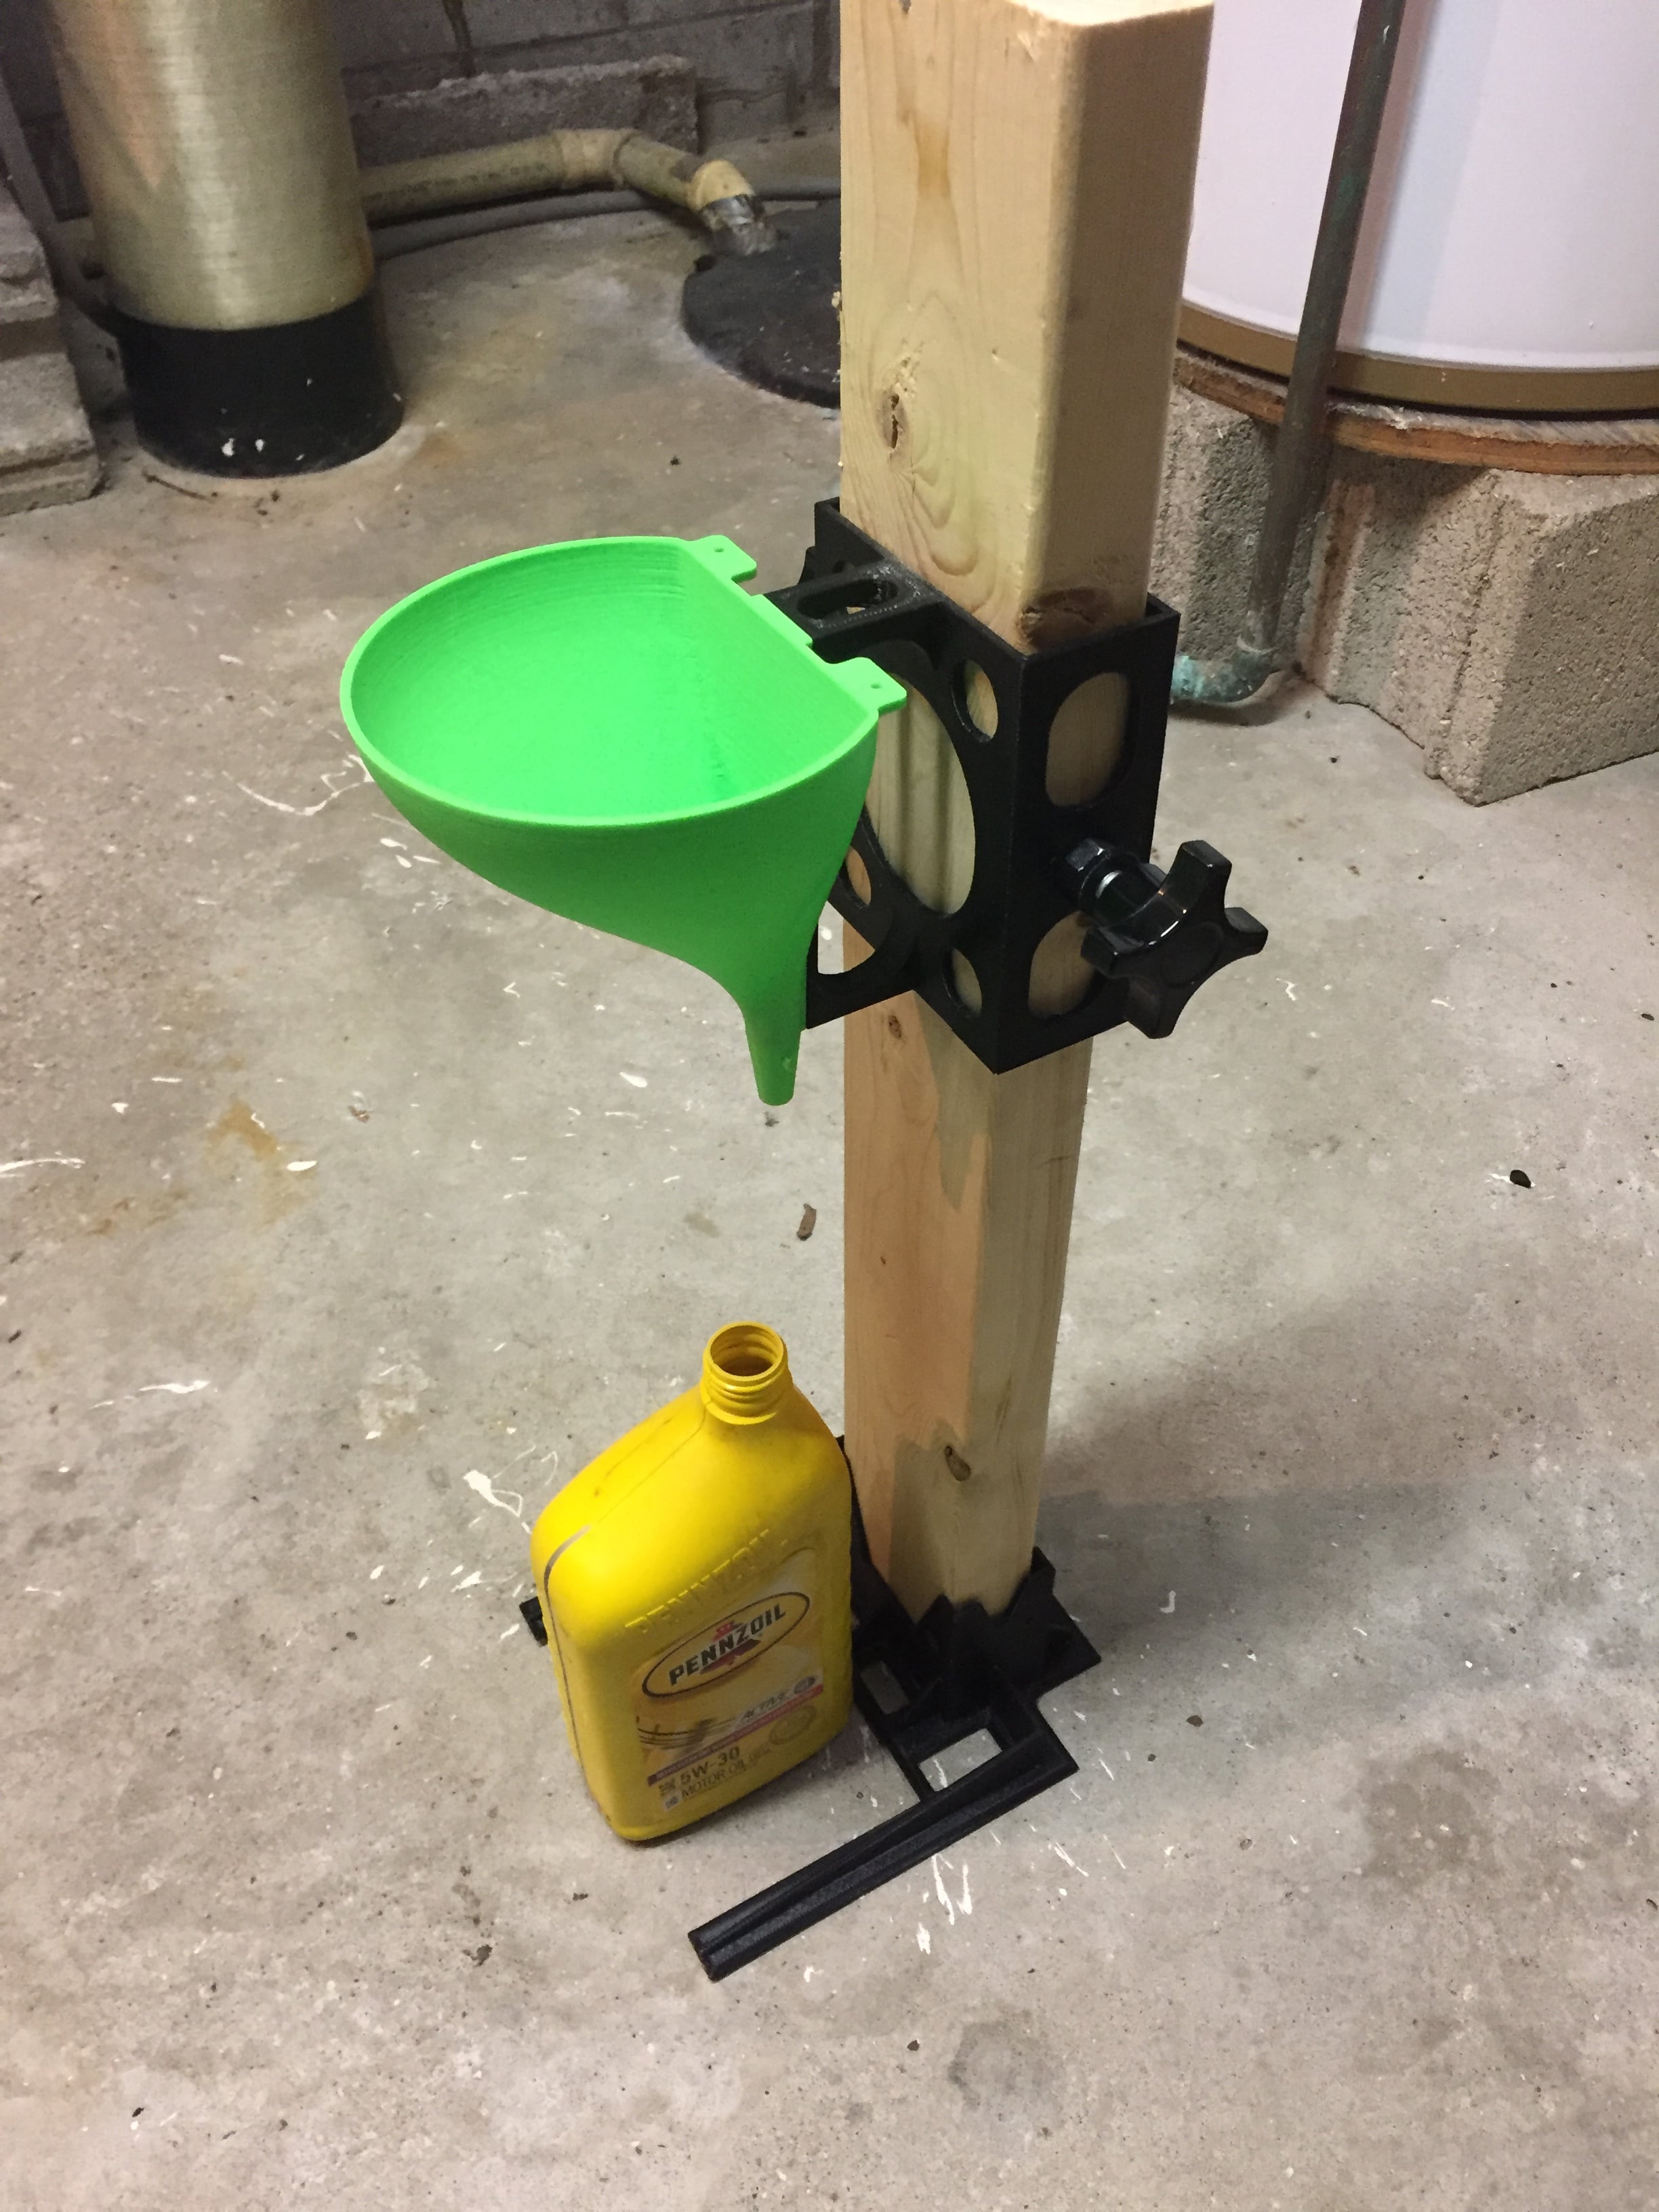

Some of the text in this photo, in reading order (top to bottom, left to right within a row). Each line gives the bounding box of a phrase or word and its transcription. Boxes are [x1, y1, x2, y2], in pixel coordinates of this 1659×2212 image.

[668, 1603, 787, 1686] PENNZOIL
[680, 1746, 740, 1784] 5W-30
[681, 1769, 727, 1799] MOTOR
[728, 1759, 747, 1776] OIL
